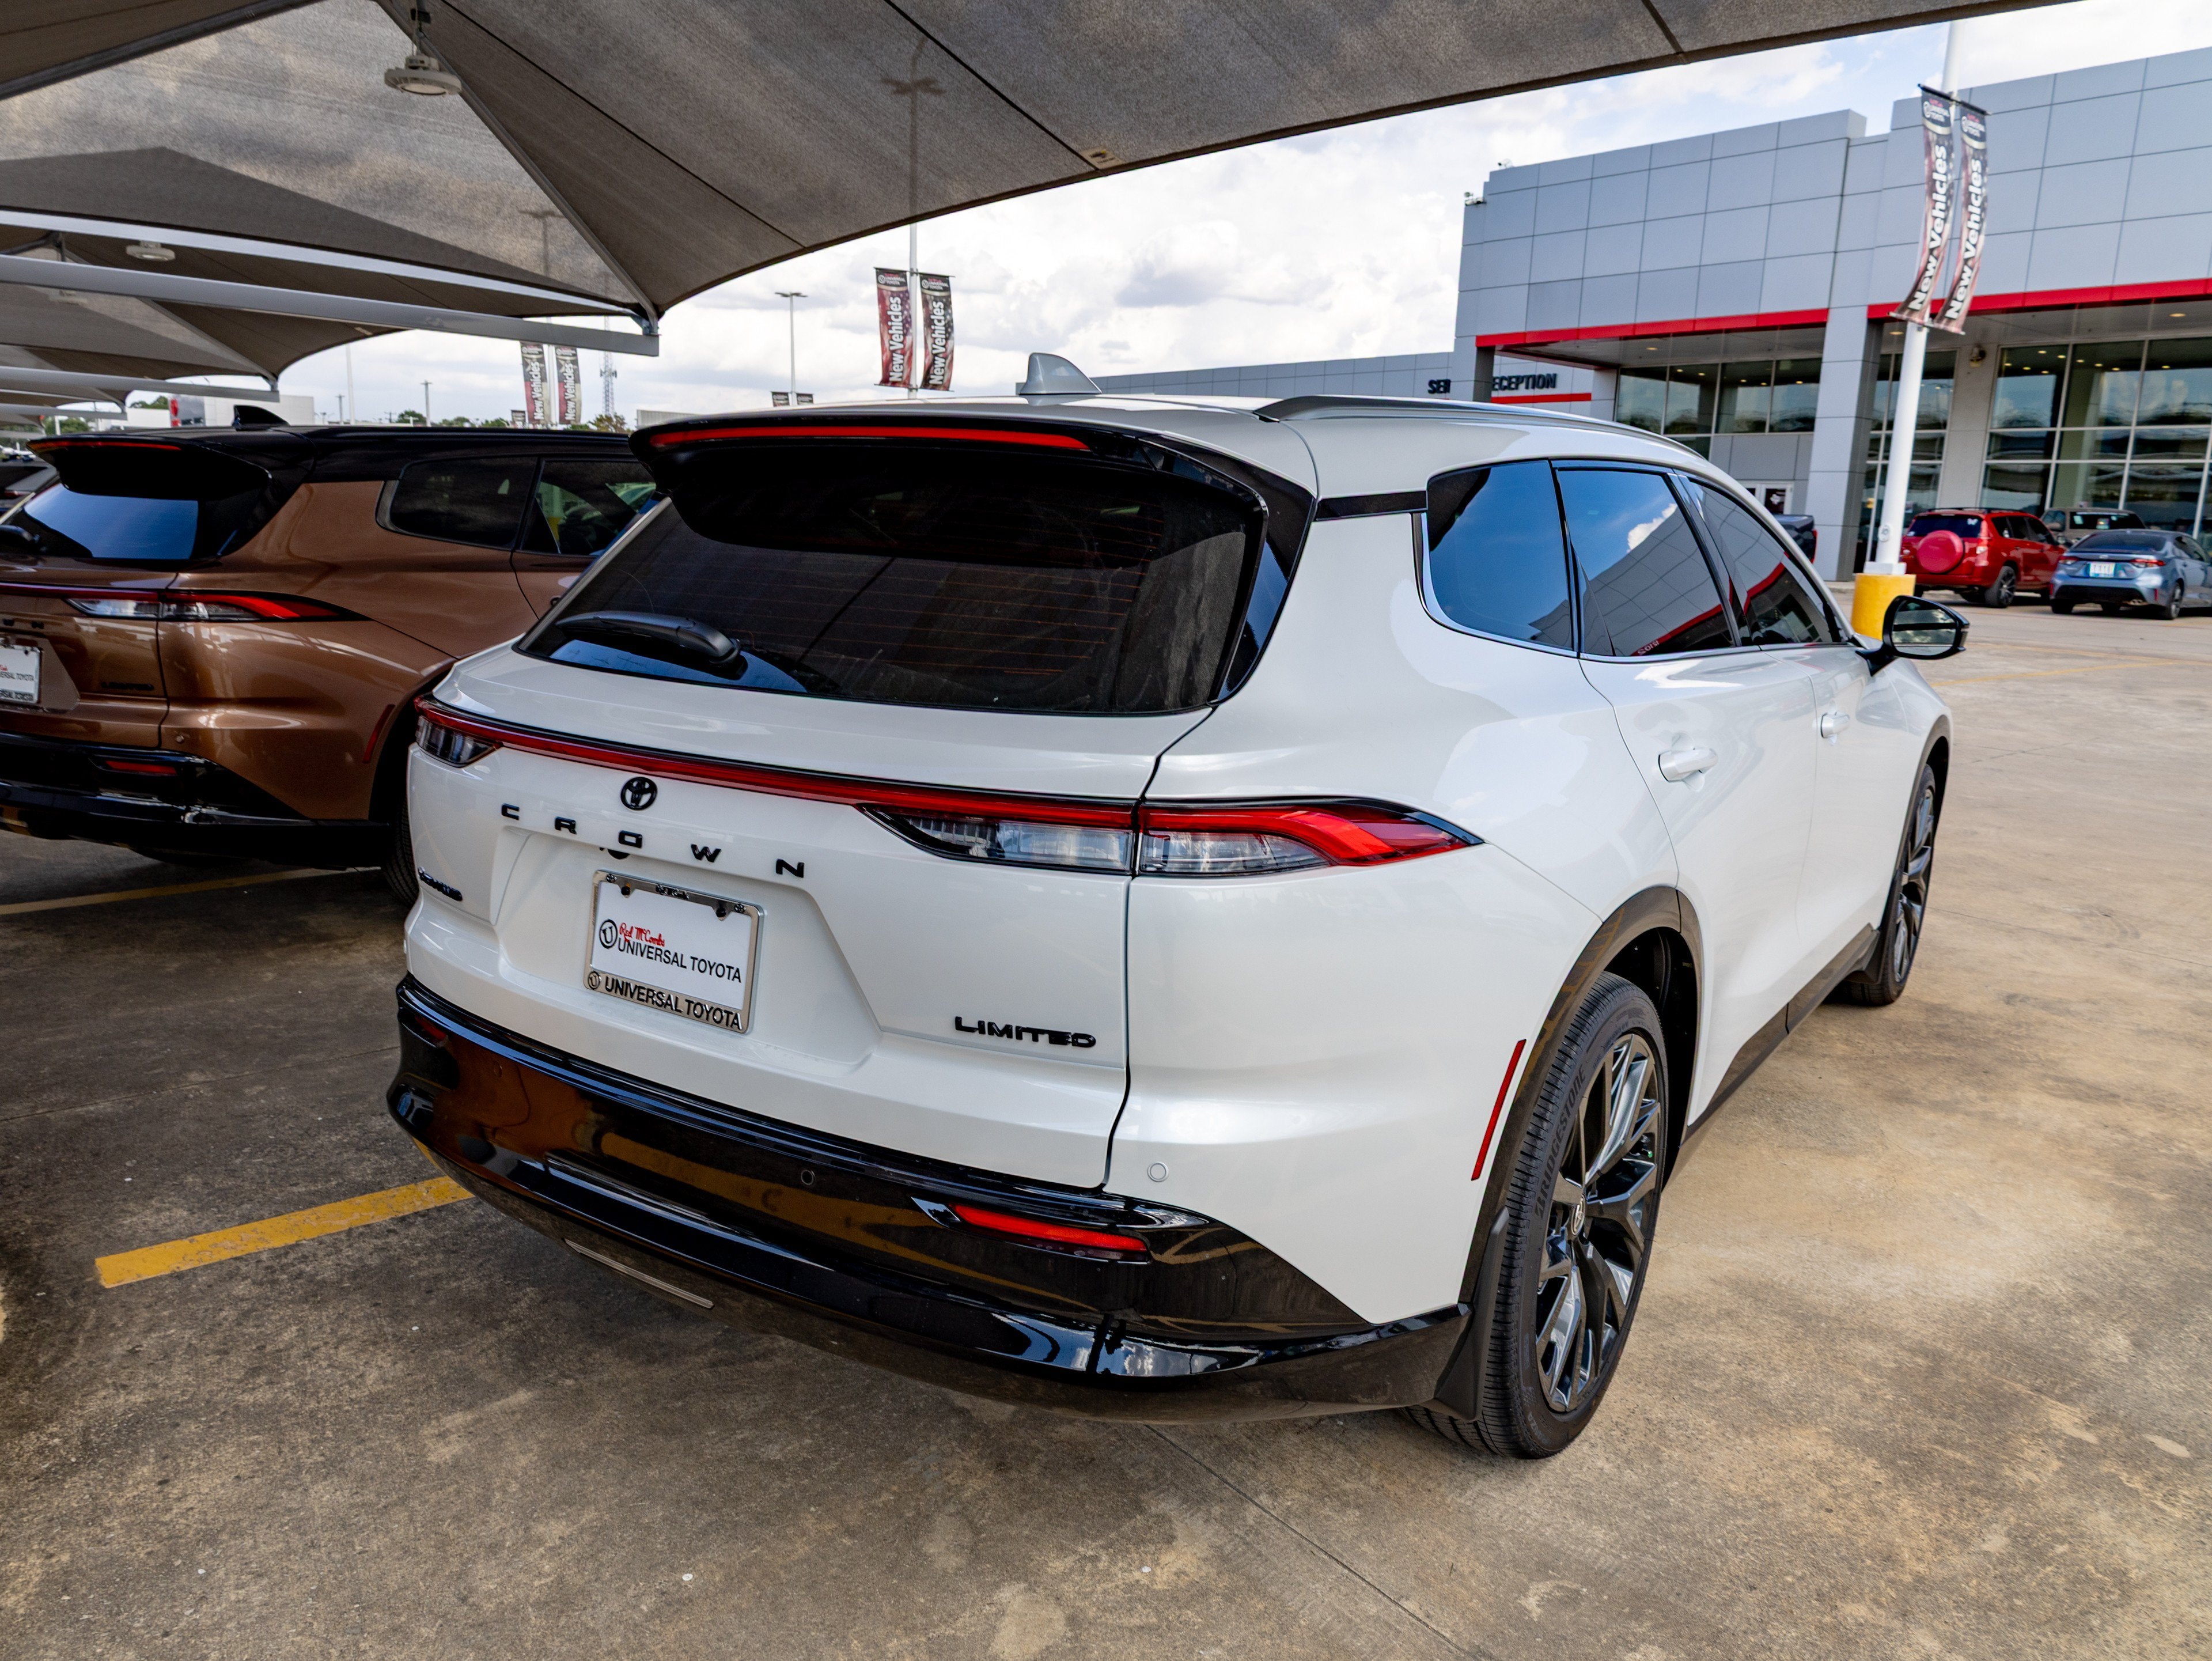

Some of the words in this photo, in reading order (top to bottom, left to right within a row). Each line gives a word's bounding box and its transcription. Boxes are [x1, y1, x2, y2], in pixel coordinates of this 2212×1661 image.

[1908, 256, 1937, 311] New
[1928, 145, 1948, 249] Vehicles
[1945, 264, 1972, 320] New
[1963, 159, 1984, 259] Vehicles
[887, 296, 904, 351] Vehicles
[930, 301, 946, 354] Vehicles
[529, 361, 543, 399] Vehicles
[563, 363, 575, 400] Vehicles
[889, 351, 904, 382] New
[929, 354, 945, 384] New
[1492, 373, 1557, 391] ECEPTION
[533, 400, 544, 419] New
[565, 401, 575, 421] New
[501, 803, 805, 878] CROWN
[619, 922, 633, 939] Red
[618, 937, 687, 969] UNIVERSAL
[690, 956, 742, 983] TOYOTA
[605, 976, 683, 1013] UNIVERSAL
[685, 1000, 743, 1030] TOYOTA
[955, 1016, 1096, 1048] LIMITED
[1535, 1065, 1586, 1220] BRIDGESTONE
